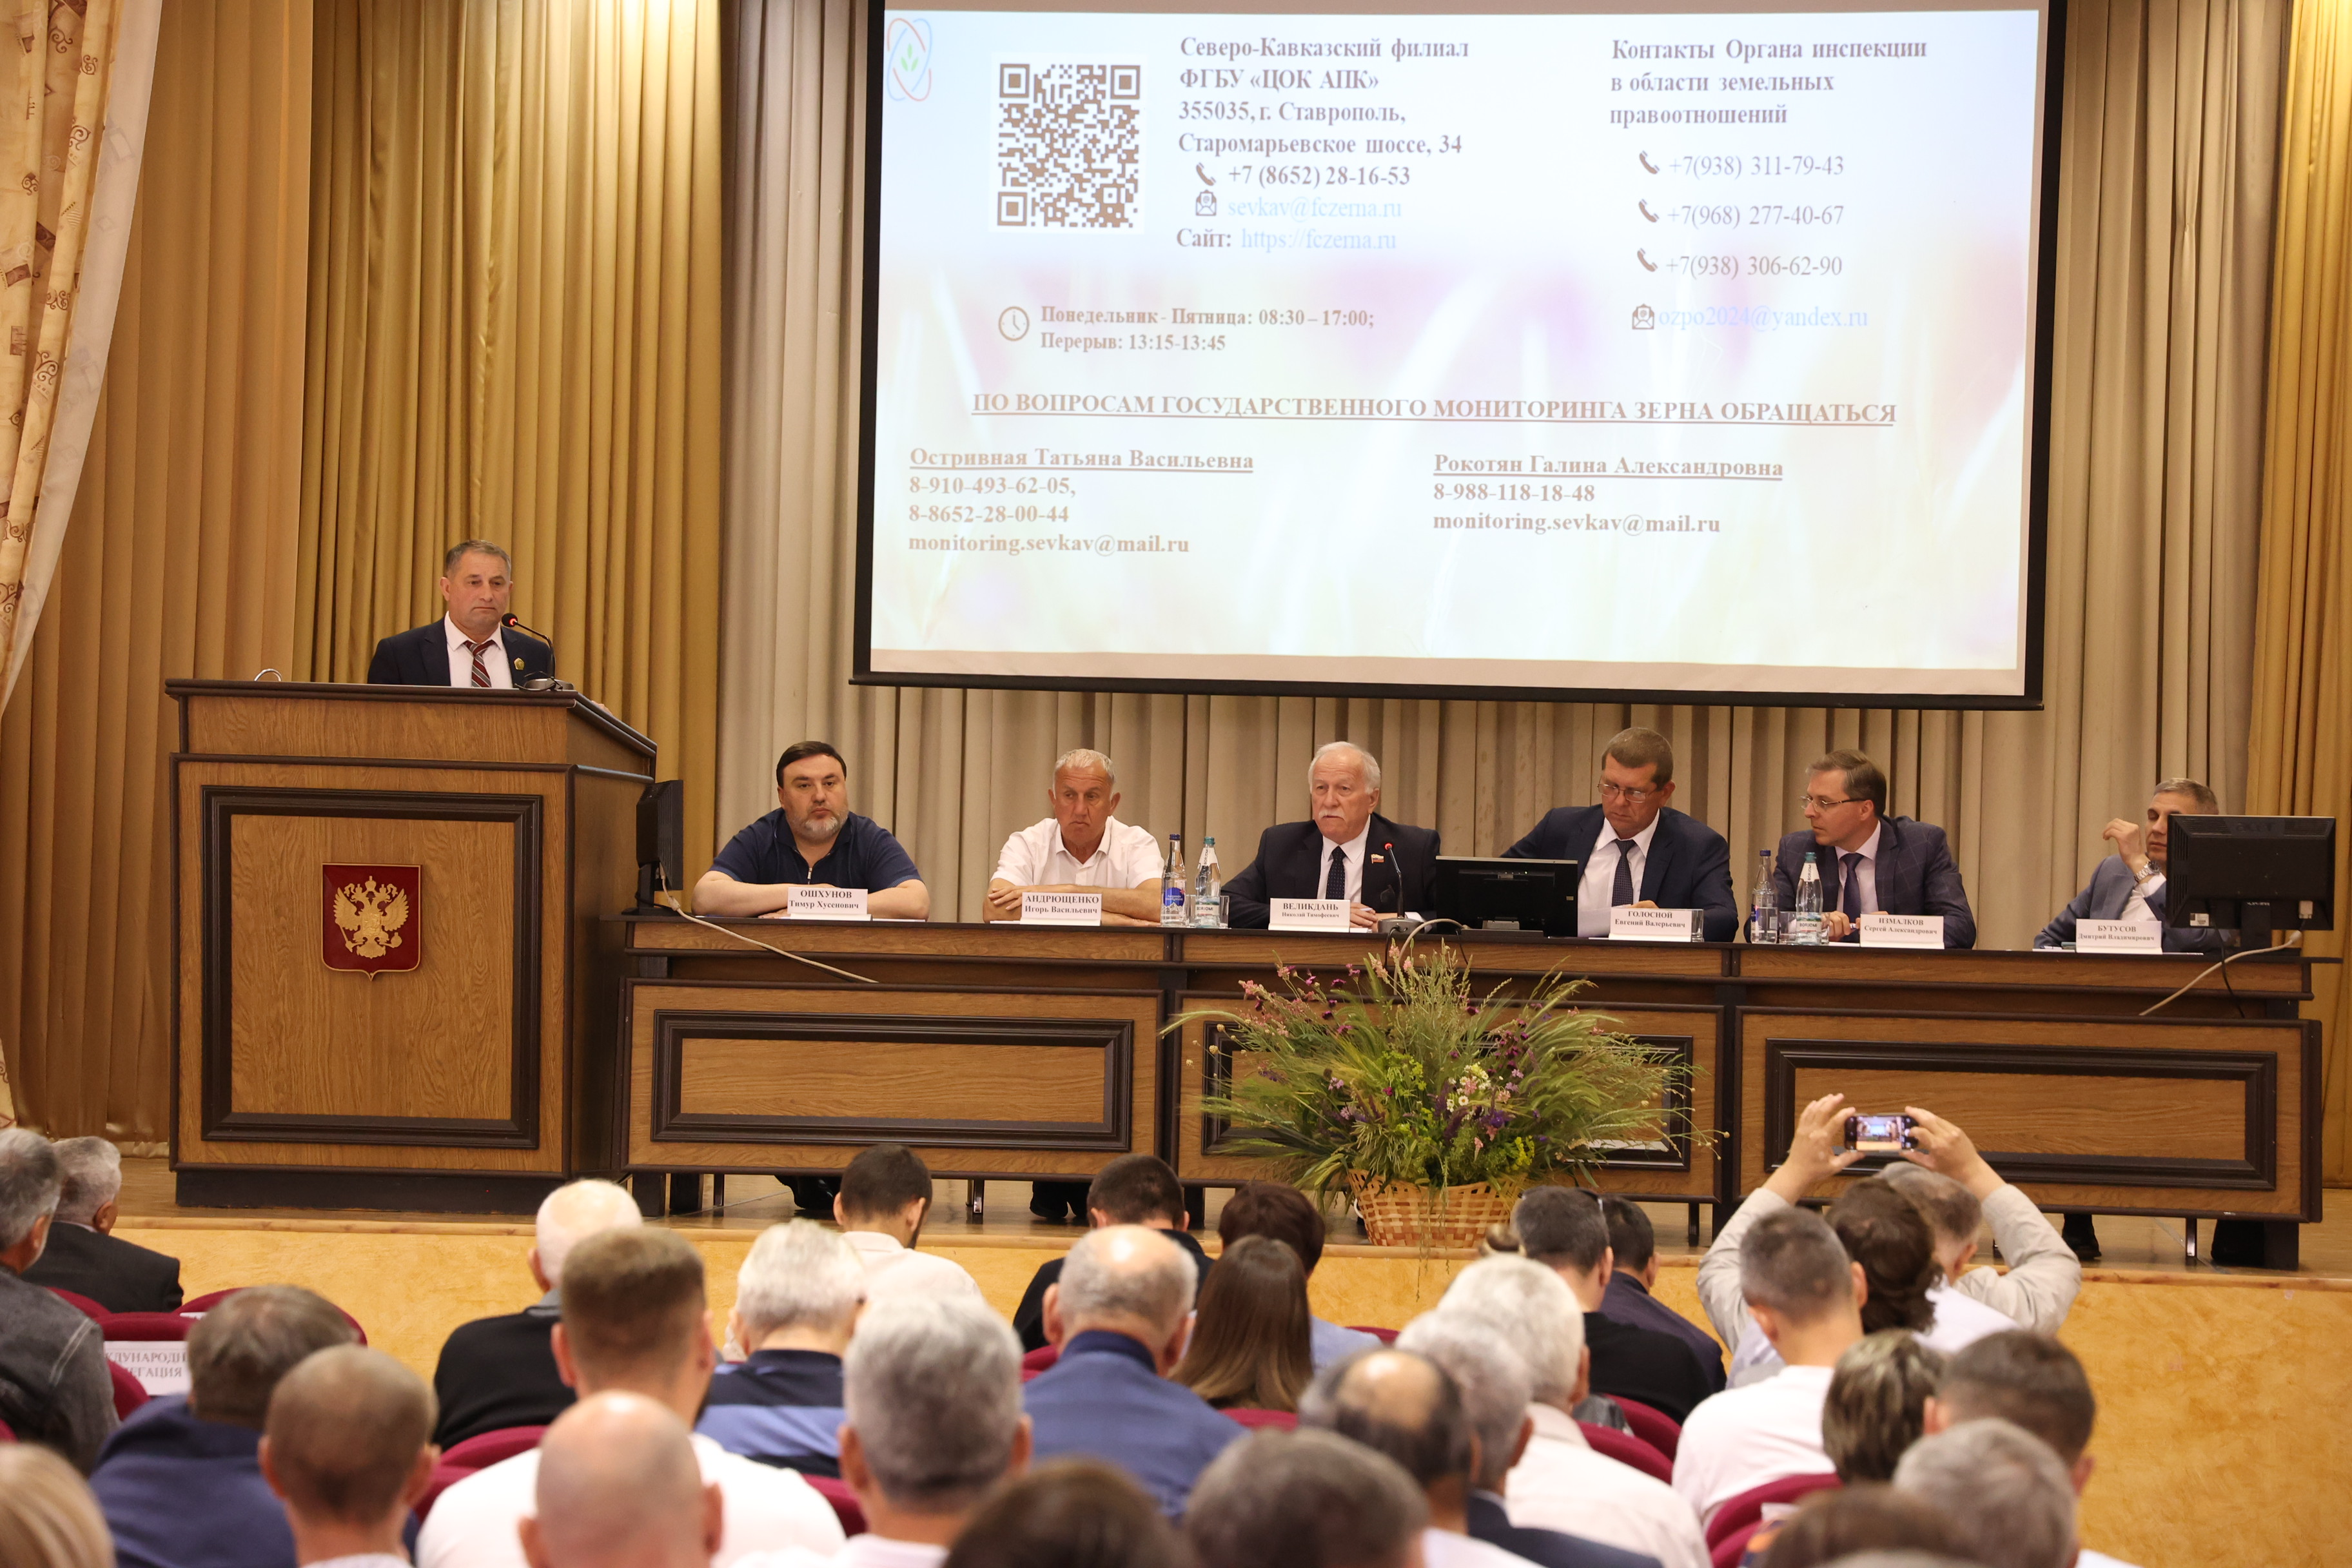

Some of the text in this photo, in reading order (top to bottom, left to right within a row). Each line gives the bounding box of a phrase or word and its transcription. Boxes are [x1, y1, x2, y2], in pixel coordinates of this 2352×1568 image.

[1181, 37, 1469, 62] Северо-Кавказский филиал
[1612, 39, 1926, 64] Контакты Органа инспекции
[1179, 68, 1379, 92] ФГБУ «ЦОК АПК»
[1611, 72, 1834, 92] в области земельных
[1179, 101, 1406, 126] 355035, г. Ставрополь,
[1610, 104, 1787, 129] правоотношений
[1178, 133, 1462, 158] Старомарьевское шоссе, 34
[1228, 164, 1410, 188] +7 (8652) 28-16-53
[1670, 155, 1844, 179] +7(938) 311-79-43
[1668, 205, 1844, 229] +7(968) 277-40-67
[1176, 228, 1231, 248] Сайт:
[1666, 255, 1843, 280] +7(938) 306-62-90
[1171, 308, 1252, 326] Пятница:
[1658, 306, 1868, 332] ozpo2024@yandex.ru
[1041, 331, 1226, 353] Перерыв: 13:15-13:45
[974, 393, 1896, 424] ПО ВОПРОСАМ ГОСУДАРСТВЕННОГО МОНИТОРИНГА ЗЕРНА ОБРАЩАТЬСЯ
[910, 447, 1253, 471] Остривная Татьяна Васильевна
[1435, 454, 1783, 478] Рокотян Галина Александровна
[909, 476, 1076, 498] 8-910-493-62-05,
[1433, 483, 1595, 502] 8-988-118-18-48
[908, 505, 1069, 523] 8-8652-28-00-44
[1433, 512, 1720, 536] monitoring.sevkav@mail.ru
[908, 533, 1189, 557] monitoring.sevkav@mail.ru
[789, 900, 859, 909] Тимур Хусенович
[800, 890, 852, 898] ОШХУНОВ
[1025, 895, 1099, 904] АНДРЮЩЕНКО
[1025, 905, 1049, 914] Игорь
[1283, 903, 1338, 911] ВЕЛИКДАНЬ
[1879, 917, 1924, 926] ИЗМАЛКОВ
